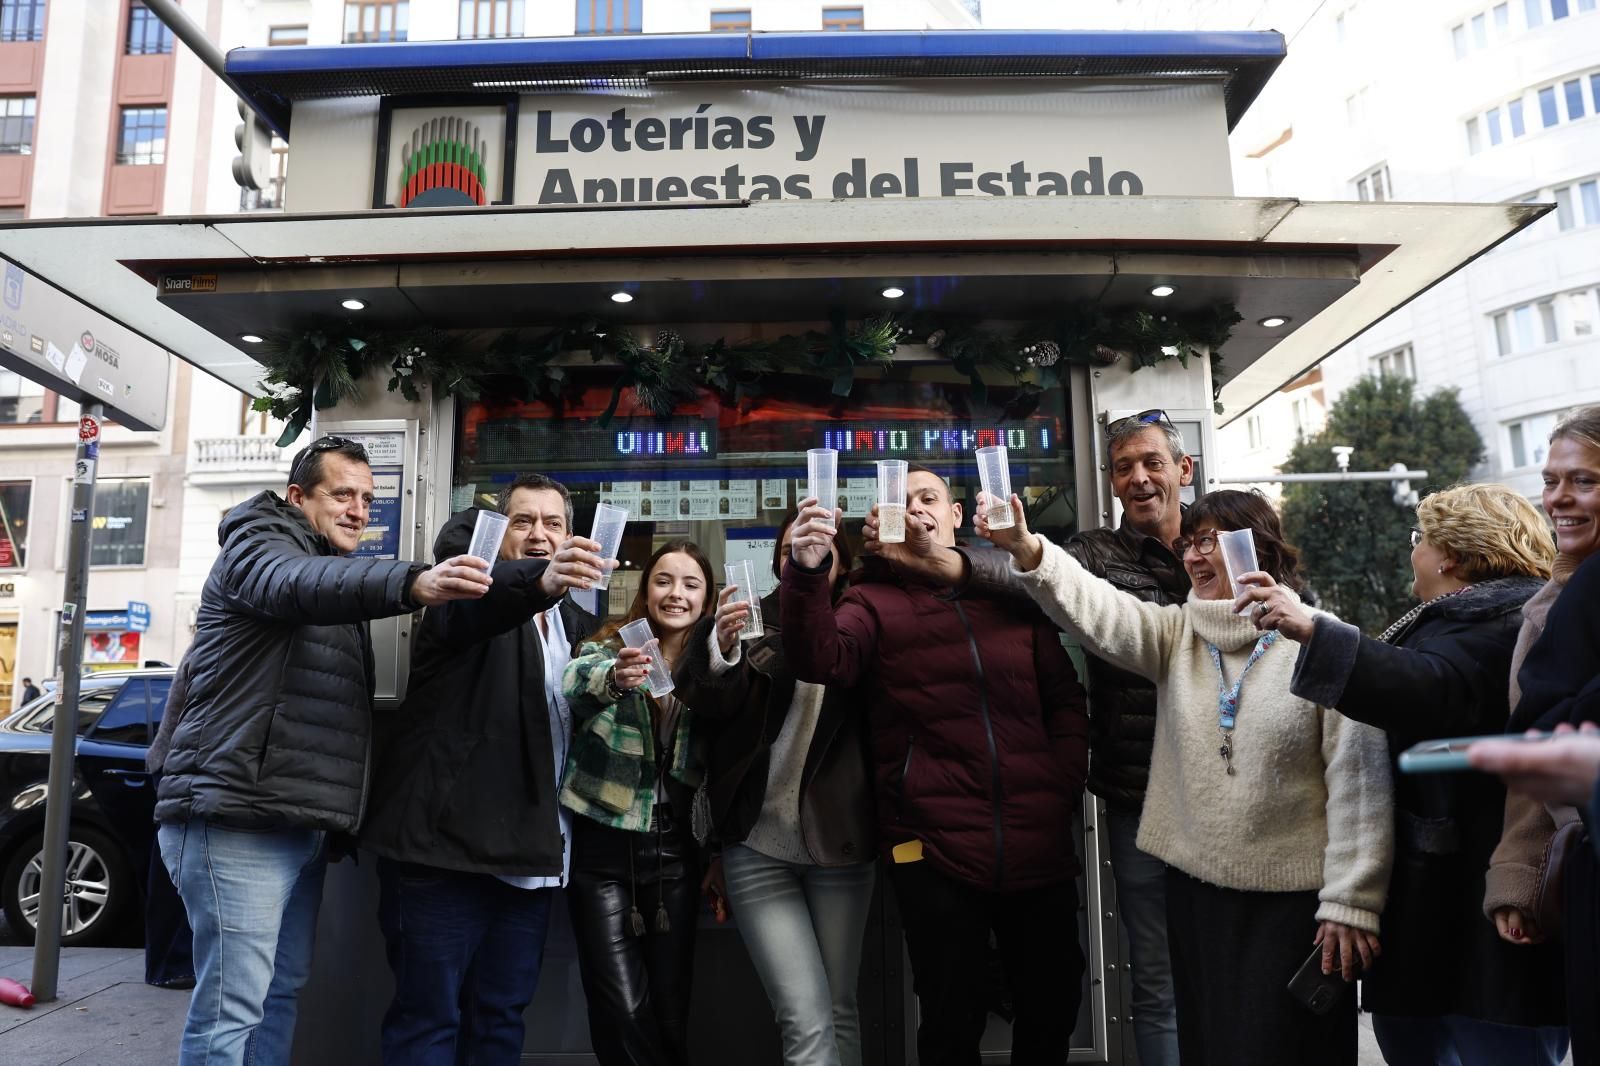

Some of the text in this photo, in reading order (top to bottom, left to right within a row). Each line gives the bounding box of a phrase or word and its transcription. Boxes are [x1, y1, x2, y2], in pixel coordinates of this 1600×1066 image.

[535, 103, 827, 162] Loterías y
[832, 157, 919, 199] del
[940, 156, 1144, 198] Estado
[165, 277, 191, 289] Snare
